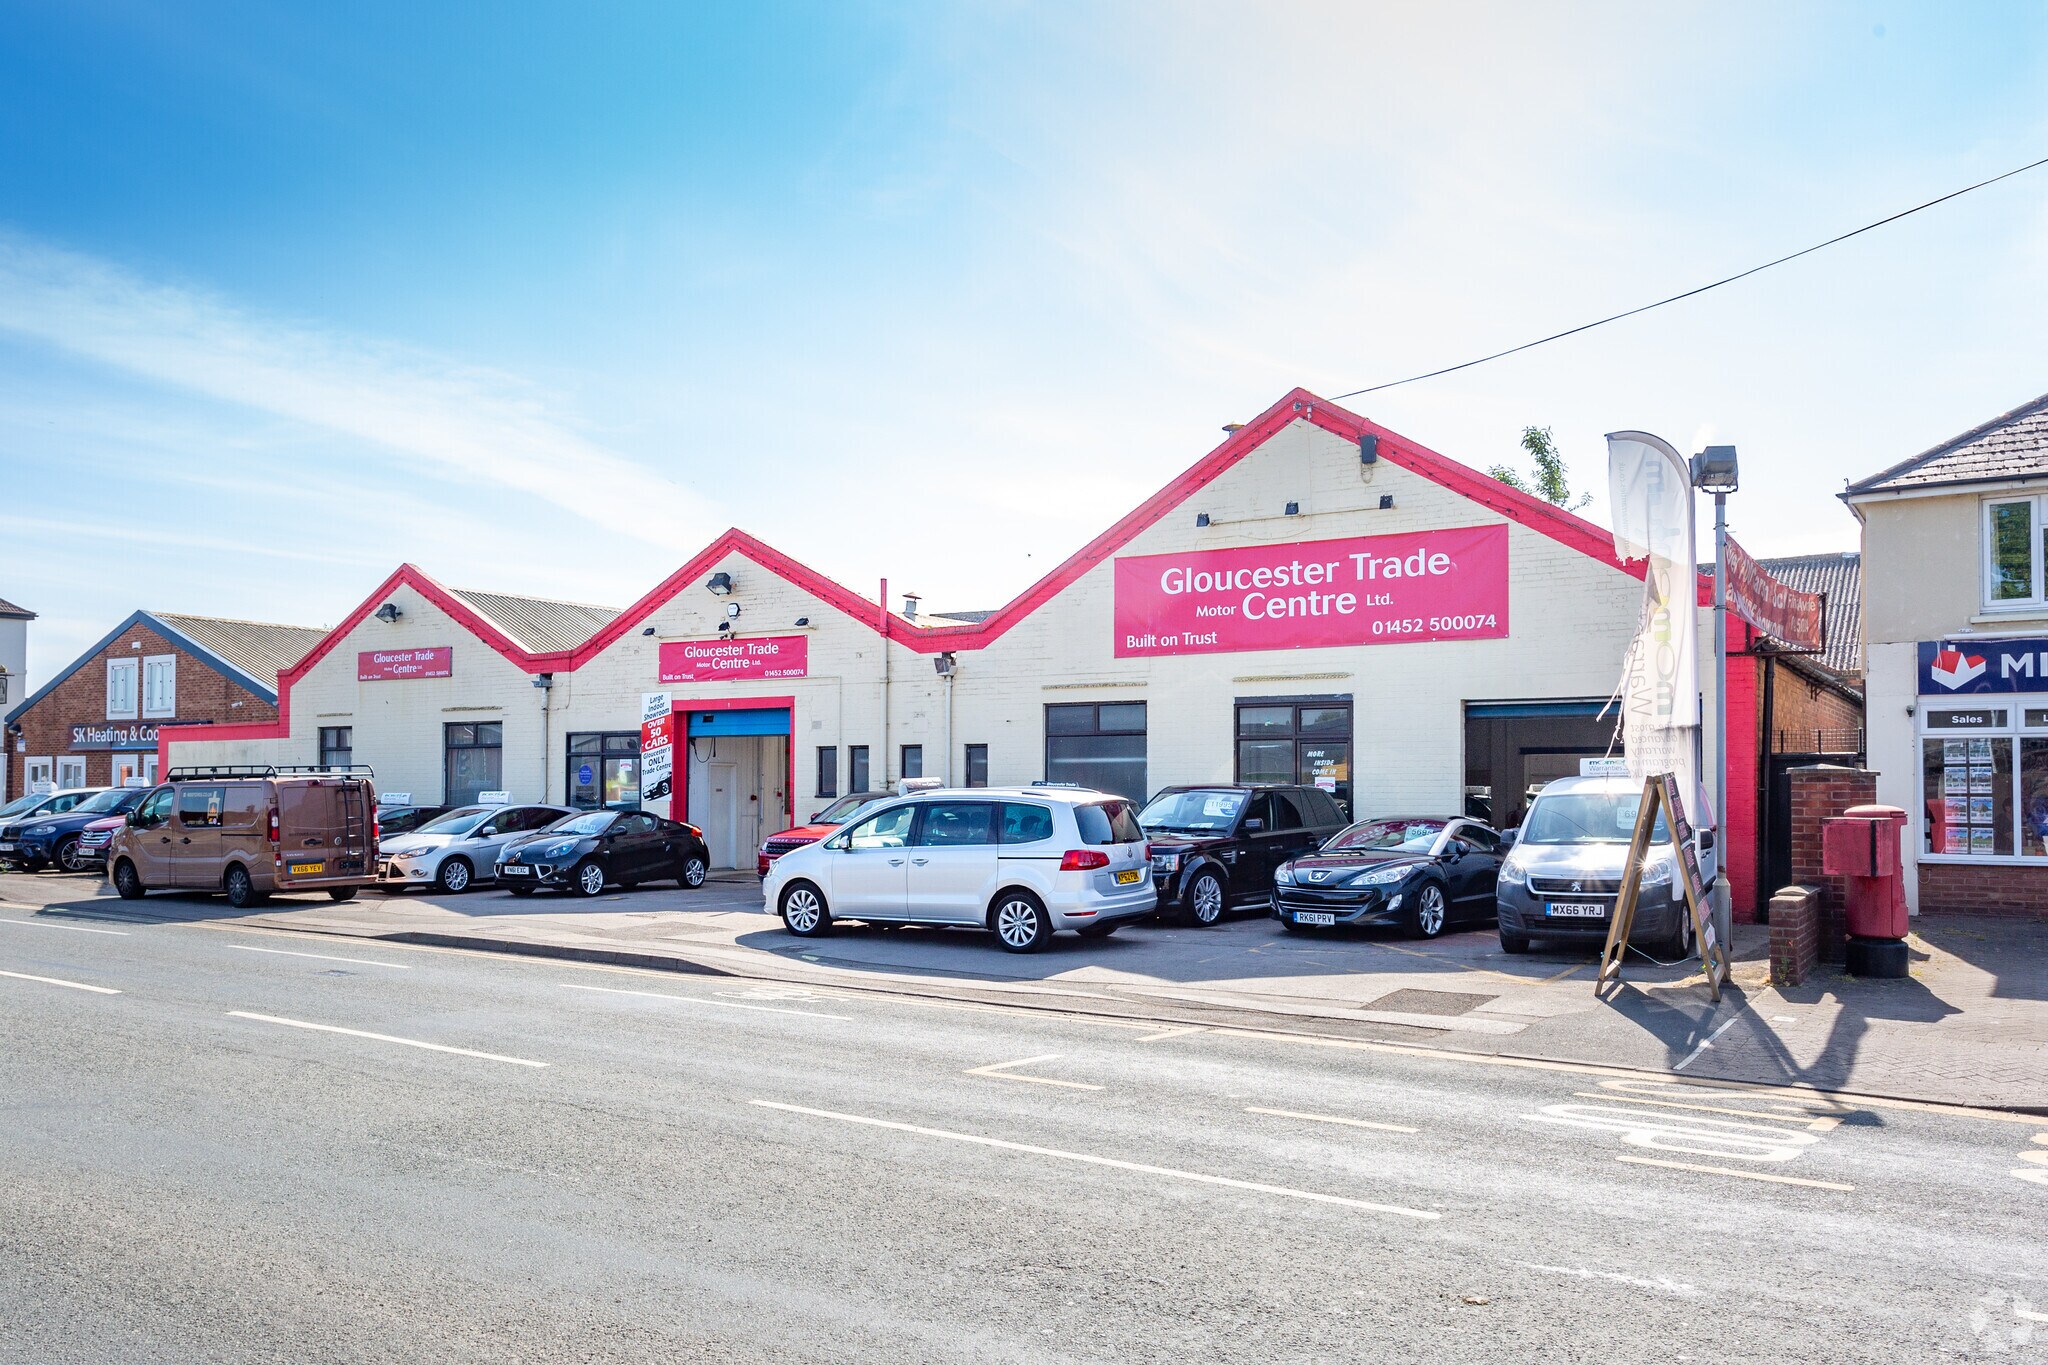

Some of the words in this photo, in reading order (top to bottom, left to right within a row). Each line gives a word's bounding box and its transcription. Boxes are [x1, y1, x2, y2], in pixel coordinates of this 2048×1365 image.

[1160, 559, 1339, 596] Gloucester
[1349, 548, 1450, 581] Trade
[1196, 603, 1237, 618] Motor
[1242, 590, 1357, 621] Centre
[1366, 592, 1394, 607] Ltd.
[1372, 618, 1424, 635] 01452
[1429, 614, 1497, 632] 500074
[1126, 633, 1157, 648] Built
[1160, 635, 1178, 647] on
[1182, 631, 1217, 645] Trust
[684, 645, 744, 658] Gloucester
[747, 642, 779, 655] Trade
[373, 652, 412, 664] Gloucester
[415, 650, 434, 661] Trade
[393, 664, 417, 674] Centre
[712, 657, 750, 670] Centre
[662, 673, 674, 681] Built
[783, 668, 804, 676] 500074
[649, 694, 664, 704] Large
[648, 702, 665, 713] Indoor
[643, 707, 670, 721] Showroom
[1951, 715, 1983, 724] Sales
[647, 717, 665, 729] OVER
[73, 727, 87, 742] SK
[87, 726, 127, 746] Heating
[130, 725, 138, 741] &
[650, 727, 662, 738] 50
[644, 734, 669, 750] CARS
[642, 746, 671, 760] Gloucester's
[1306, 750, 1325, 758] MORE
[648, 755, 665, 767] ONLY
[642, 767, 655, 776] Trade
[655, 762, 672, 772] Centre
[292, 865, 309, 873] VX66
[309, 864, 321, 872] YEV
[1552, 904, 1579, 915] MX66
[1582, 905, 1602, 916] YRJ
[1299, 913, 1316, 922] RK61
[1317, 914, 1332, 923] PRV
